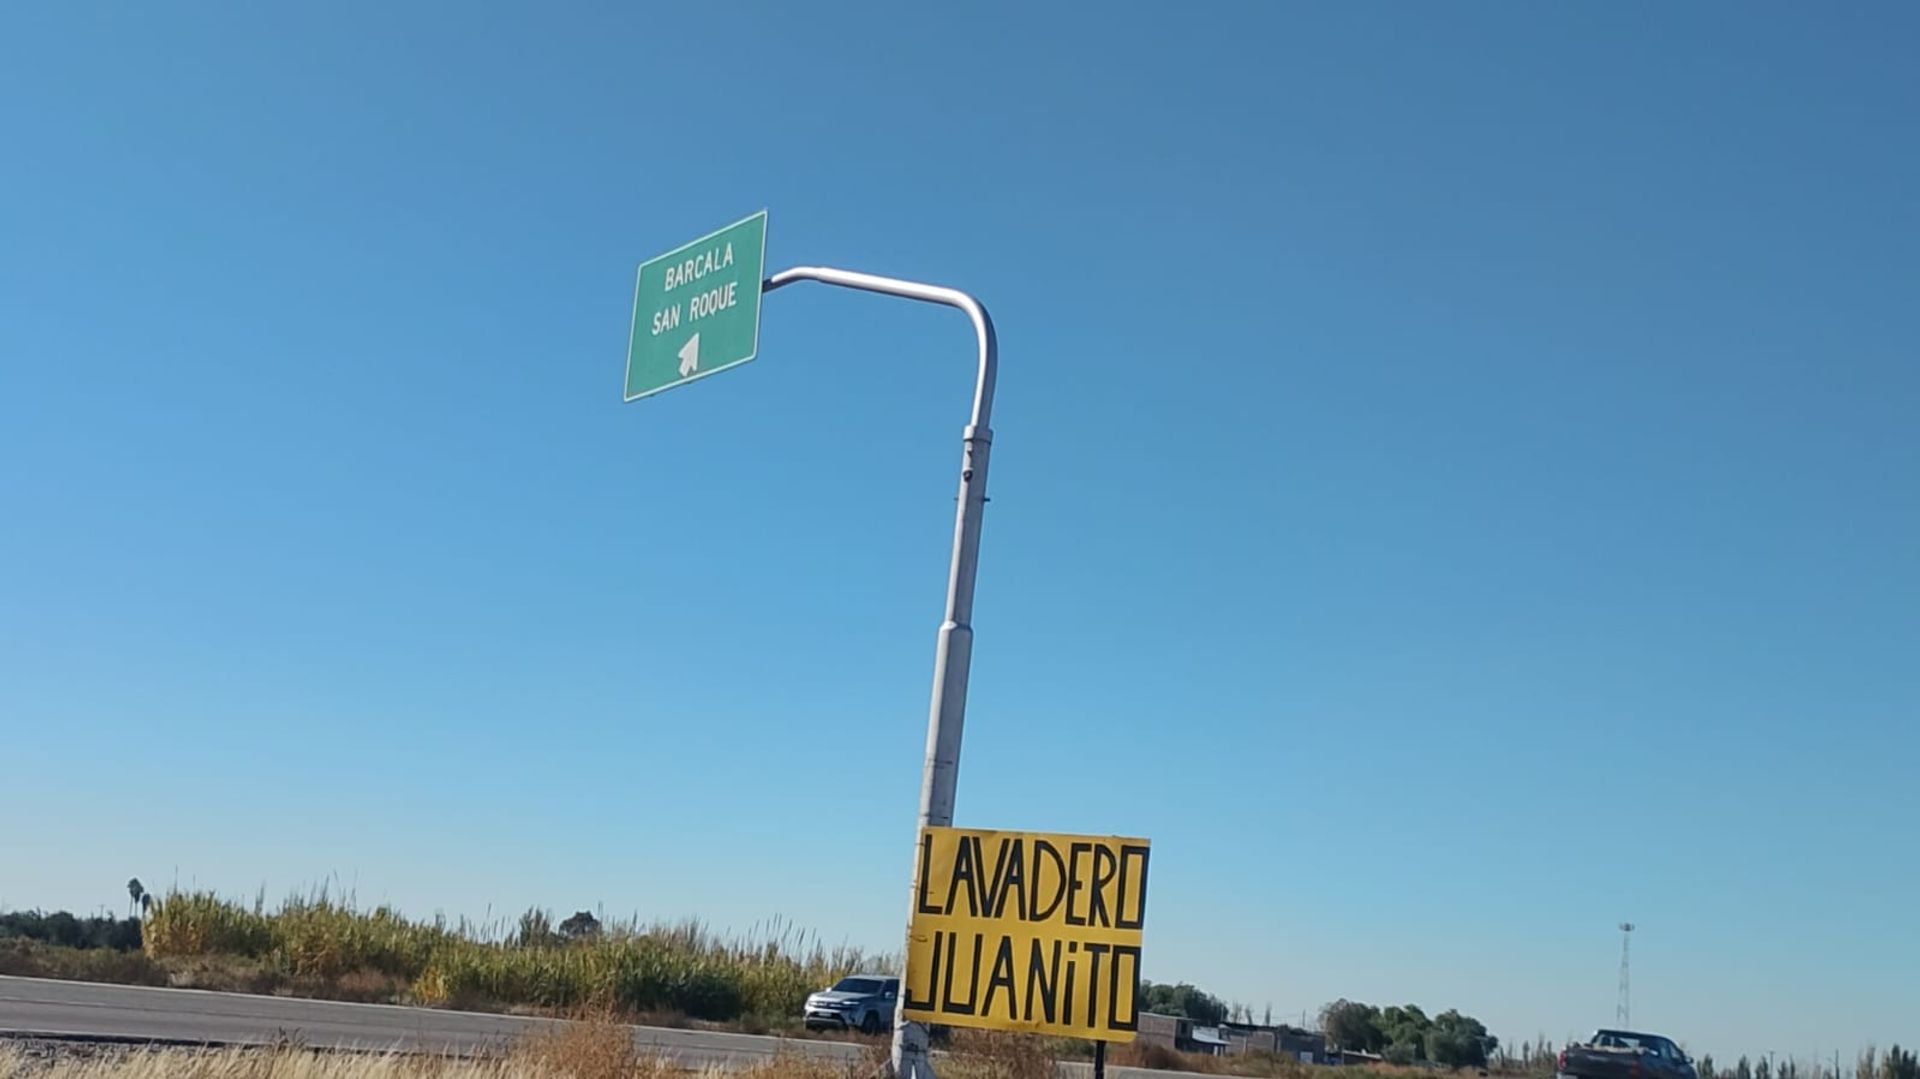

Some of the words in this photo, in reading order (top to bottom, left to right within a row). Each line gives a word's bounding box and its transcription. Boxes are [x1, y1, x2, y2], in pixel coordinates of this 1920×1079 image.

[664, 242, 733, 292] BARCALA
[651, 303, 681, 336] SAN
[689, 281, 738, 322] ROQUE
[919, 834, 1151, 930] LAVADERO
